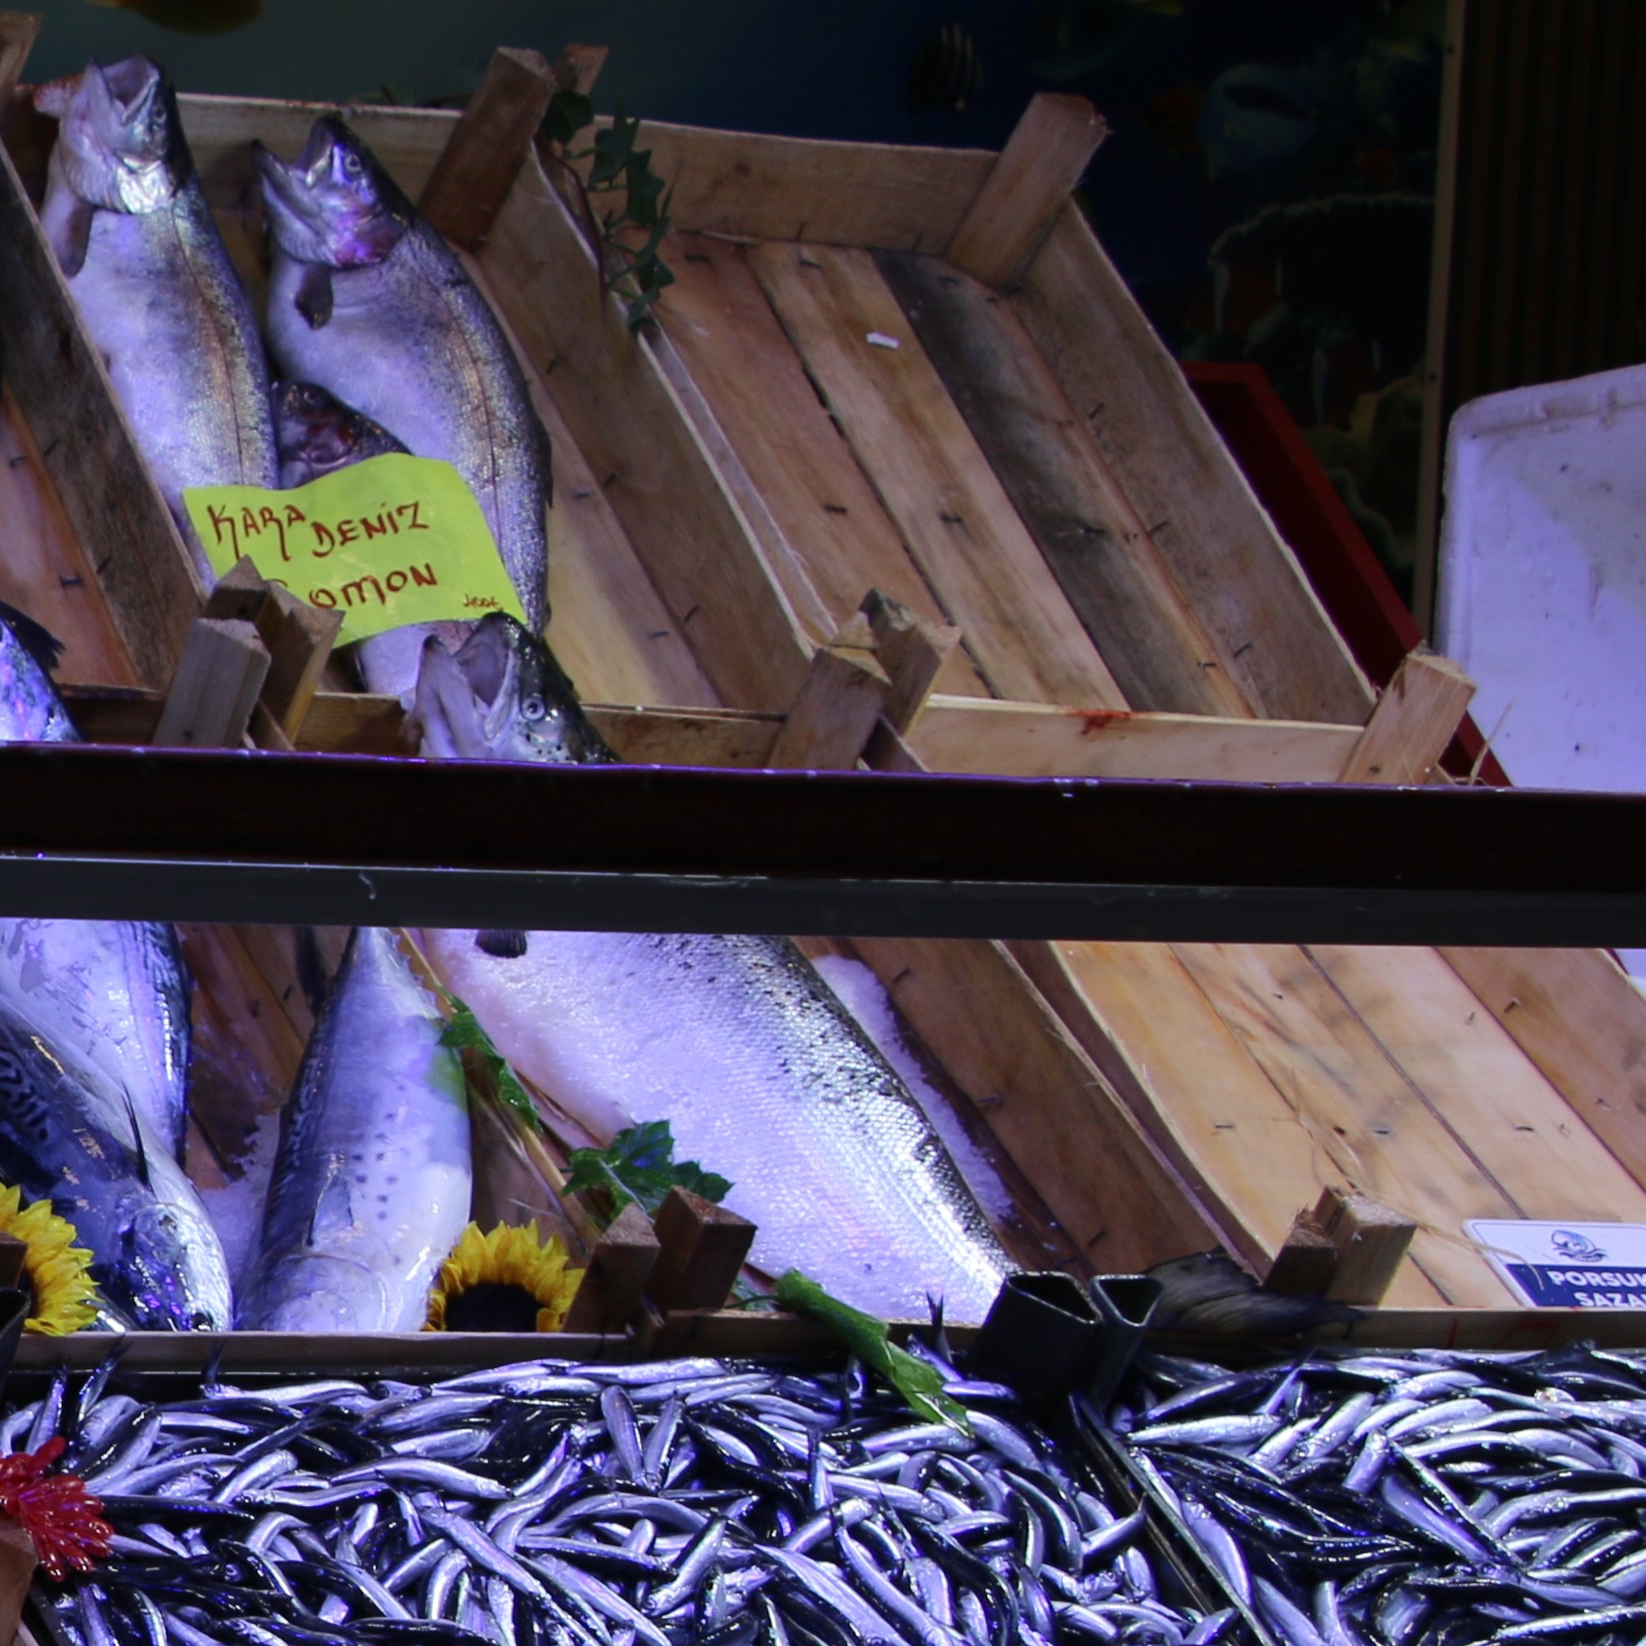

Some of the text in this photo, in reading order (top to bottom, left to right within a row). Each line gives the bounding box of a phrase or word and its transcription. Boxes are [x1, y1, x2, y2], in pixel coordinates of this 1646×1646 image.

[206, 501, 429, 562] KARA DENİZ
[263, 562, 439, 610] OMON
[1573, 1292, 1646, 1308] SAZA
